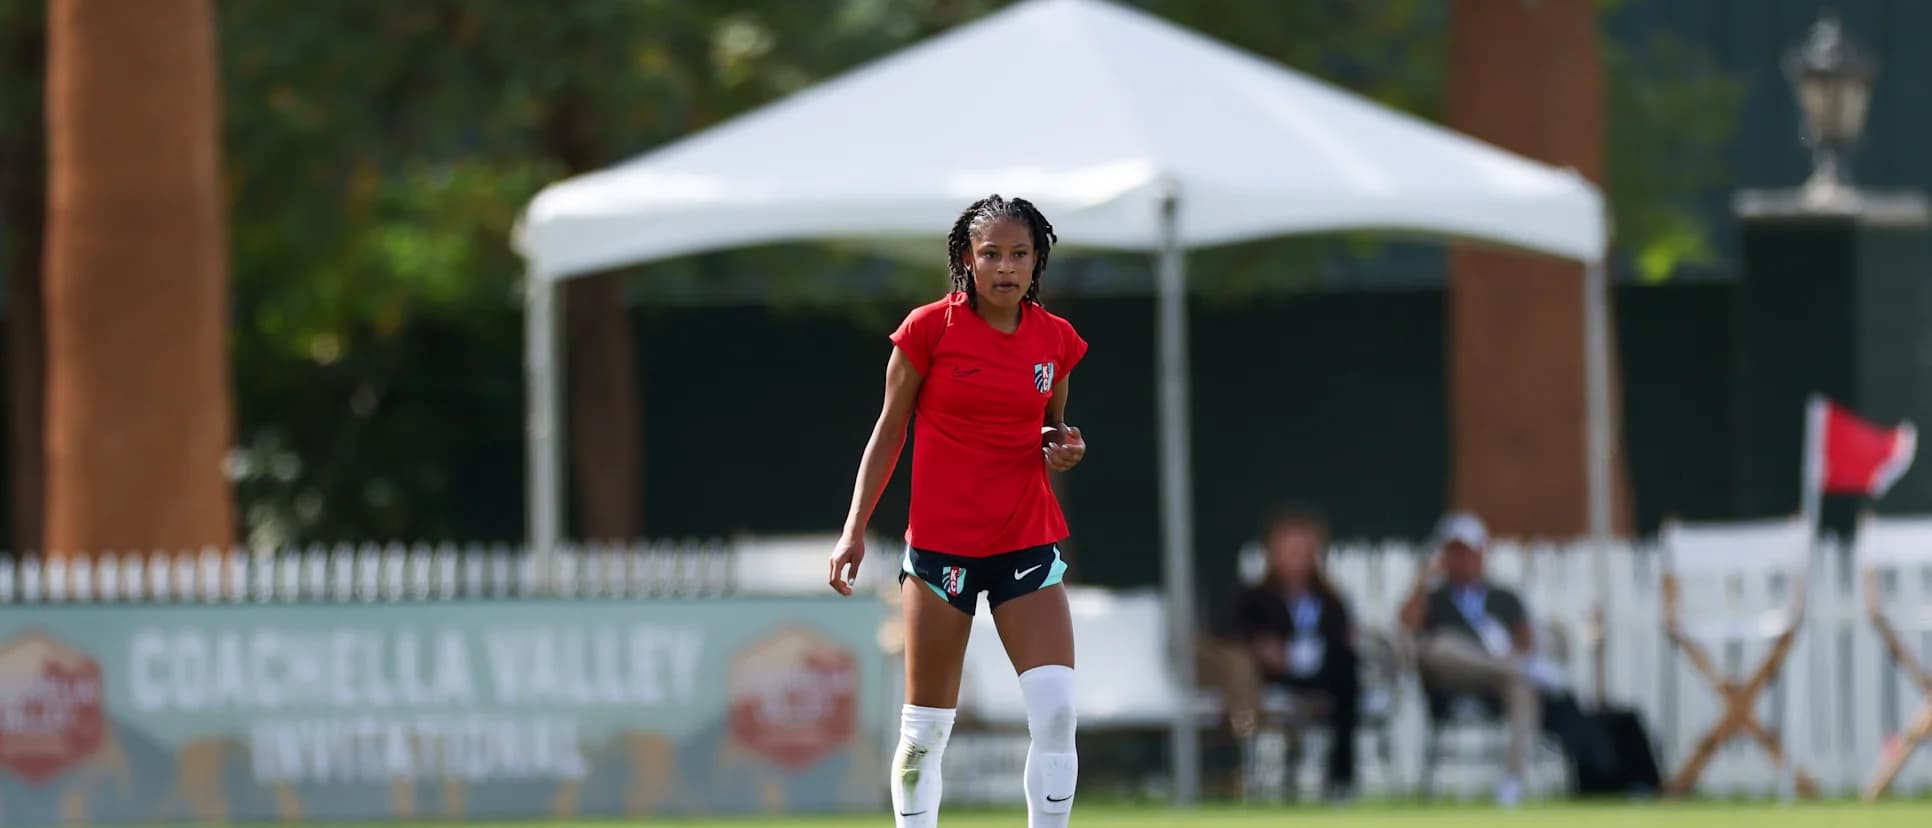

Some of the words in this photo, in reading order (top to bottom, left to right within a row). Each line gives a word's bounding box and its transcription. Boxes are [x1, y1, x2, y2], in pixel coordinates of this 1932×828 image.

[130, 628, 472, 709] COACHELLA
[483, 625, 703, 706] VALLEY
[251, 717, 589, 783] INVITATIONAL
